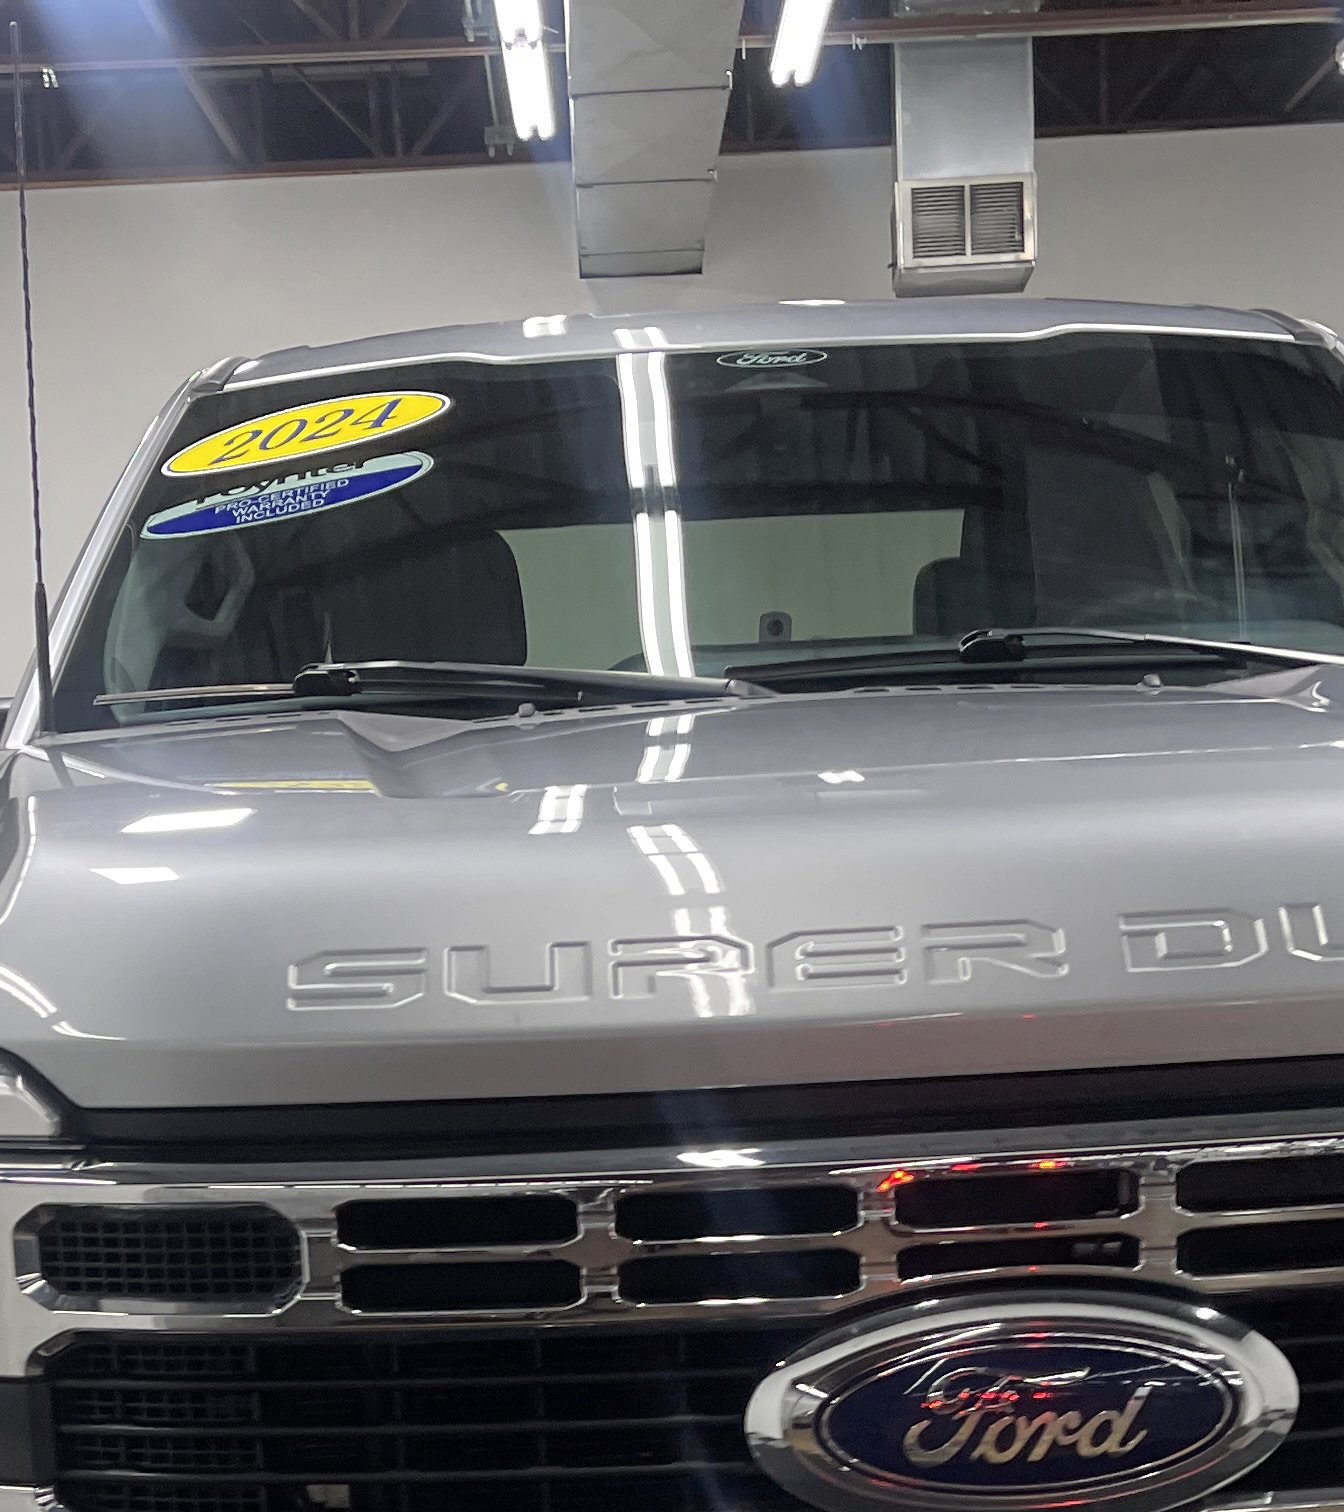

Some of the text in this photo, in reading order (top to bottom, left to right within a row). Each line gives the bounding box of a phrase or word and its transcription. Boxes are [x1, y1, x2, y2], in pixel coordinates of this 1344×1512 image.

[736, 352, 808, 365] Ford
[208, 397, 404, 467] 2024
[214, 478, 350, 515] PRO-CERTIFIED
[231, 489, 331, 518] WARRANTY
[235, 498, 326, 524] INCLUDED
[286, 918, 1070, 1011] SUPER
[902, 1358, 1154, 1468] Ford
